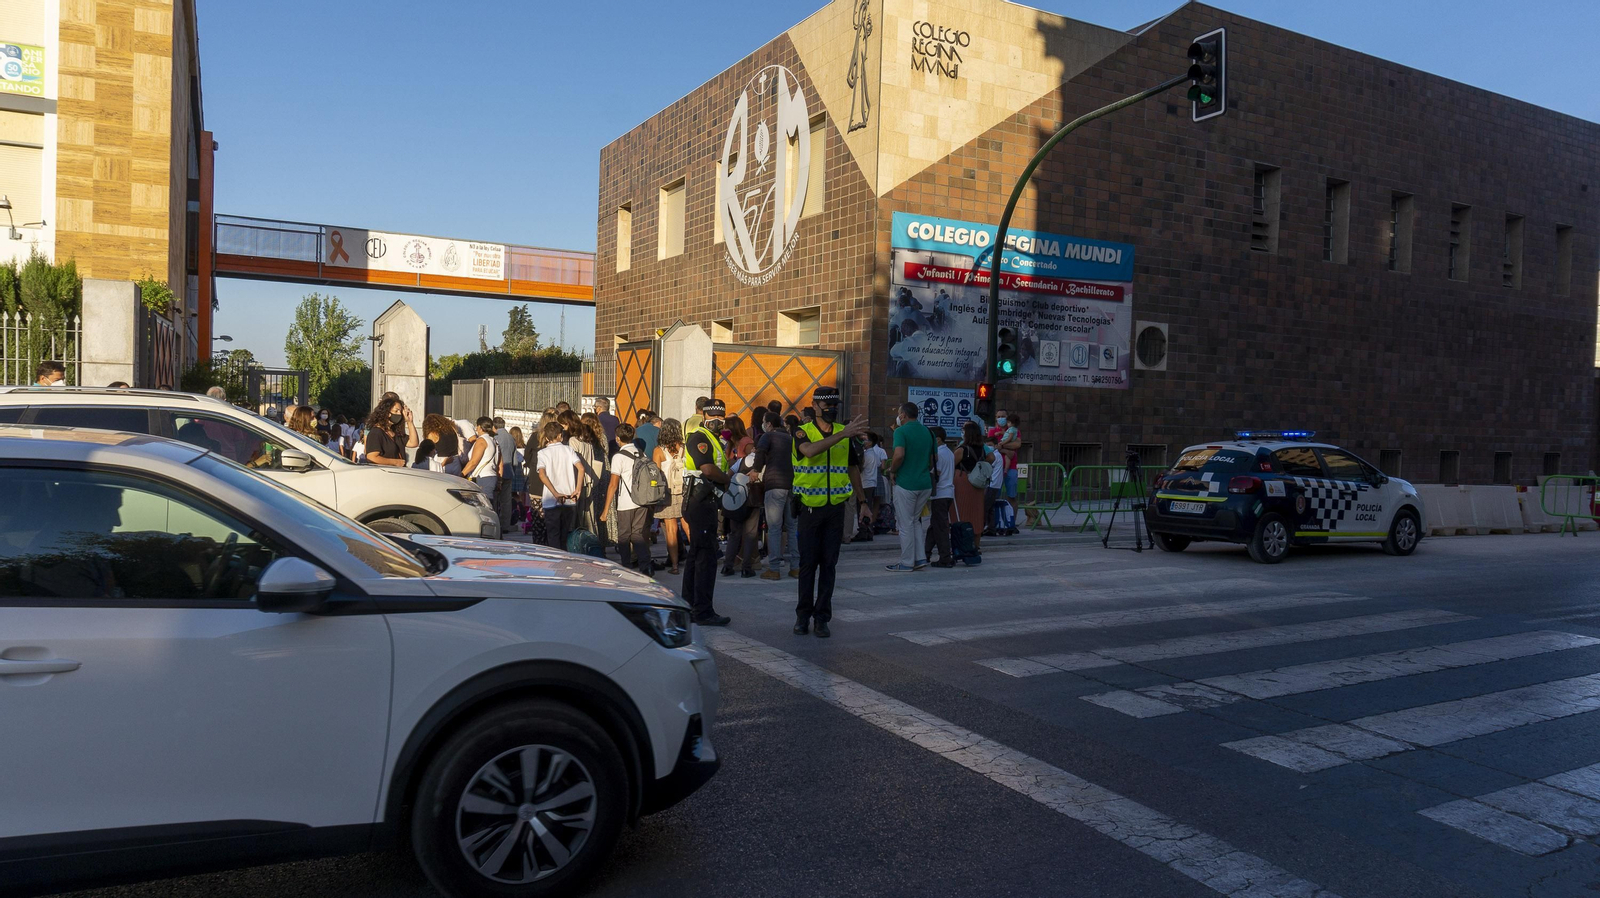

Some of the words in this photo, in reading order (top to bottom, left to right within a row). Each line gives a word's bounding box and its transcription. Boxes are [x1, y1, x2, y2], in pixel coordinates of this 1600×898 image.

[913, 21, 970, 47] COLEGIO
[24, 48, 42, 57] ANI
[912, 37, 962, 63] REGINA
[23, 54, 43, 64] VER
[8, 64, 18, 72] 50
[22, 61, 37, 69] SA
[22, 68, 41, 76] RIO
[0, 82, 41, 94] TANDO
[907, 221, 990, 247] COLEGIO
[1064, 242, 1122, 265] MUNDI
[473, 259, 500, 268] LIBERTAD
[747, 276, 762, 287] PARA
[762, 263, 782, 285] SERVIR
[781, 231, 801, 267] MEJOR
[1011, 256, 1058, 270] Concertado
[917, 266, 955, 279] Infantil
[1012, 277, 1058, 291] Secundaria
[1065, 283, 1115, 297] Bachillerato
[1032, 300, 1049, 309] Club
[950, 303, 976, 314] Inglés
[977, 306, 988, 314] de
[1038, 311, 1066, 322] Nuevas
[1028, 320, 1063, 331] Comedor
[926, 332, 940, 342] Por
[946, 335, 963, 347] para
[907, 345, 921, 353] una
[921, 343, 954, 356] educación
[954, 346, 982, 361] integral
[917, 355, 926, 366] de
[926, 359, 953, 368] nuestros
[954, 358, 970, 373] hijos
[1209, 455, 1235, 464] LOCAL
[1356, 503, 1383, 513] POLICÍA
[1355, 513, 1377, 522] LOCAL
